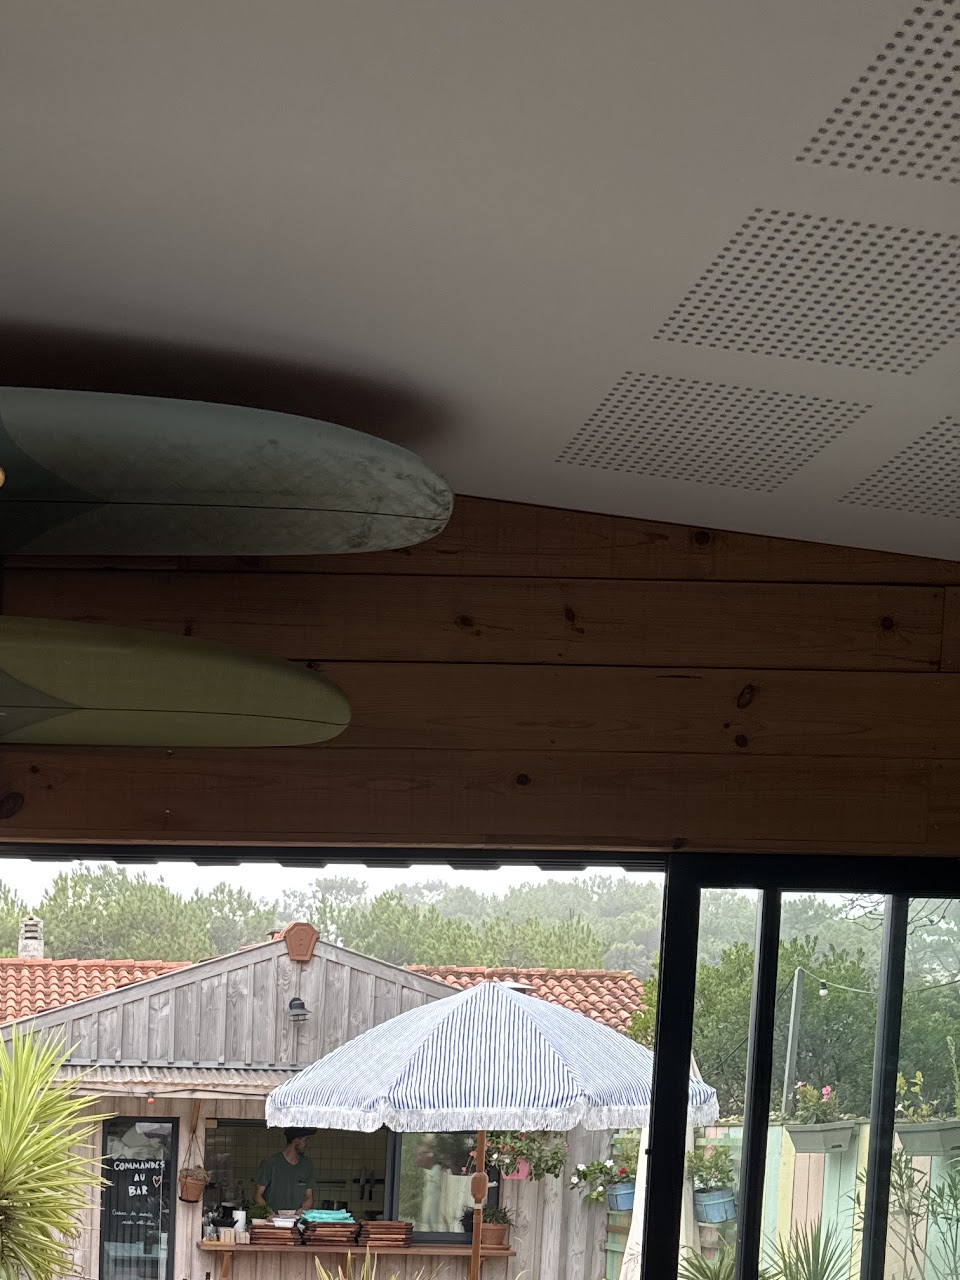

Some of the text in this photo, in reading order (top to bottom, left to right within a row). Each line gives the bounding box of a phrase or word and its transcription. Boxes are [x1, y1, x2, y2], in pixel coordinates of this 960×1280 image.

[113, 1160, 165, 1171] COMMANDES
[133, 1173, 146, 1182] AU
[128, 1185, 148, 1197] BAR
